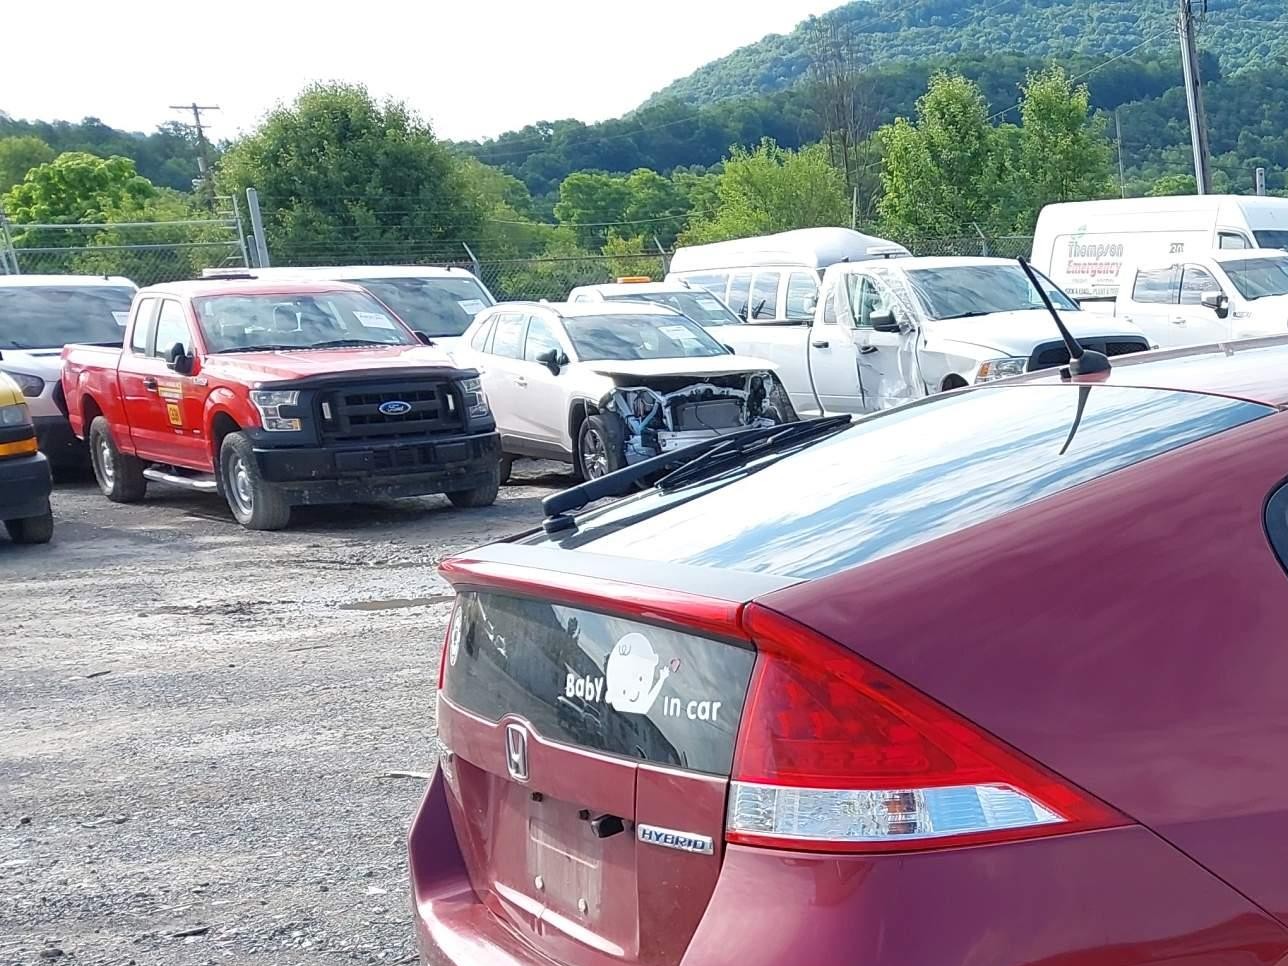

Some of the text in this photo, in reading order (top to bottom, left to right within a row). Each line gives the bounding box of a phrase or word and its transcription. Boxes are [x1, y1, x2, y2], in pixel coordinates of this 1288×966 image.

[1067, 241, 1124, 260] Thompson
[1066, 259, 1122, 278] Emergency
[686, 700, 721, 721] car
[641, 828, 706, 850] HYBRID
